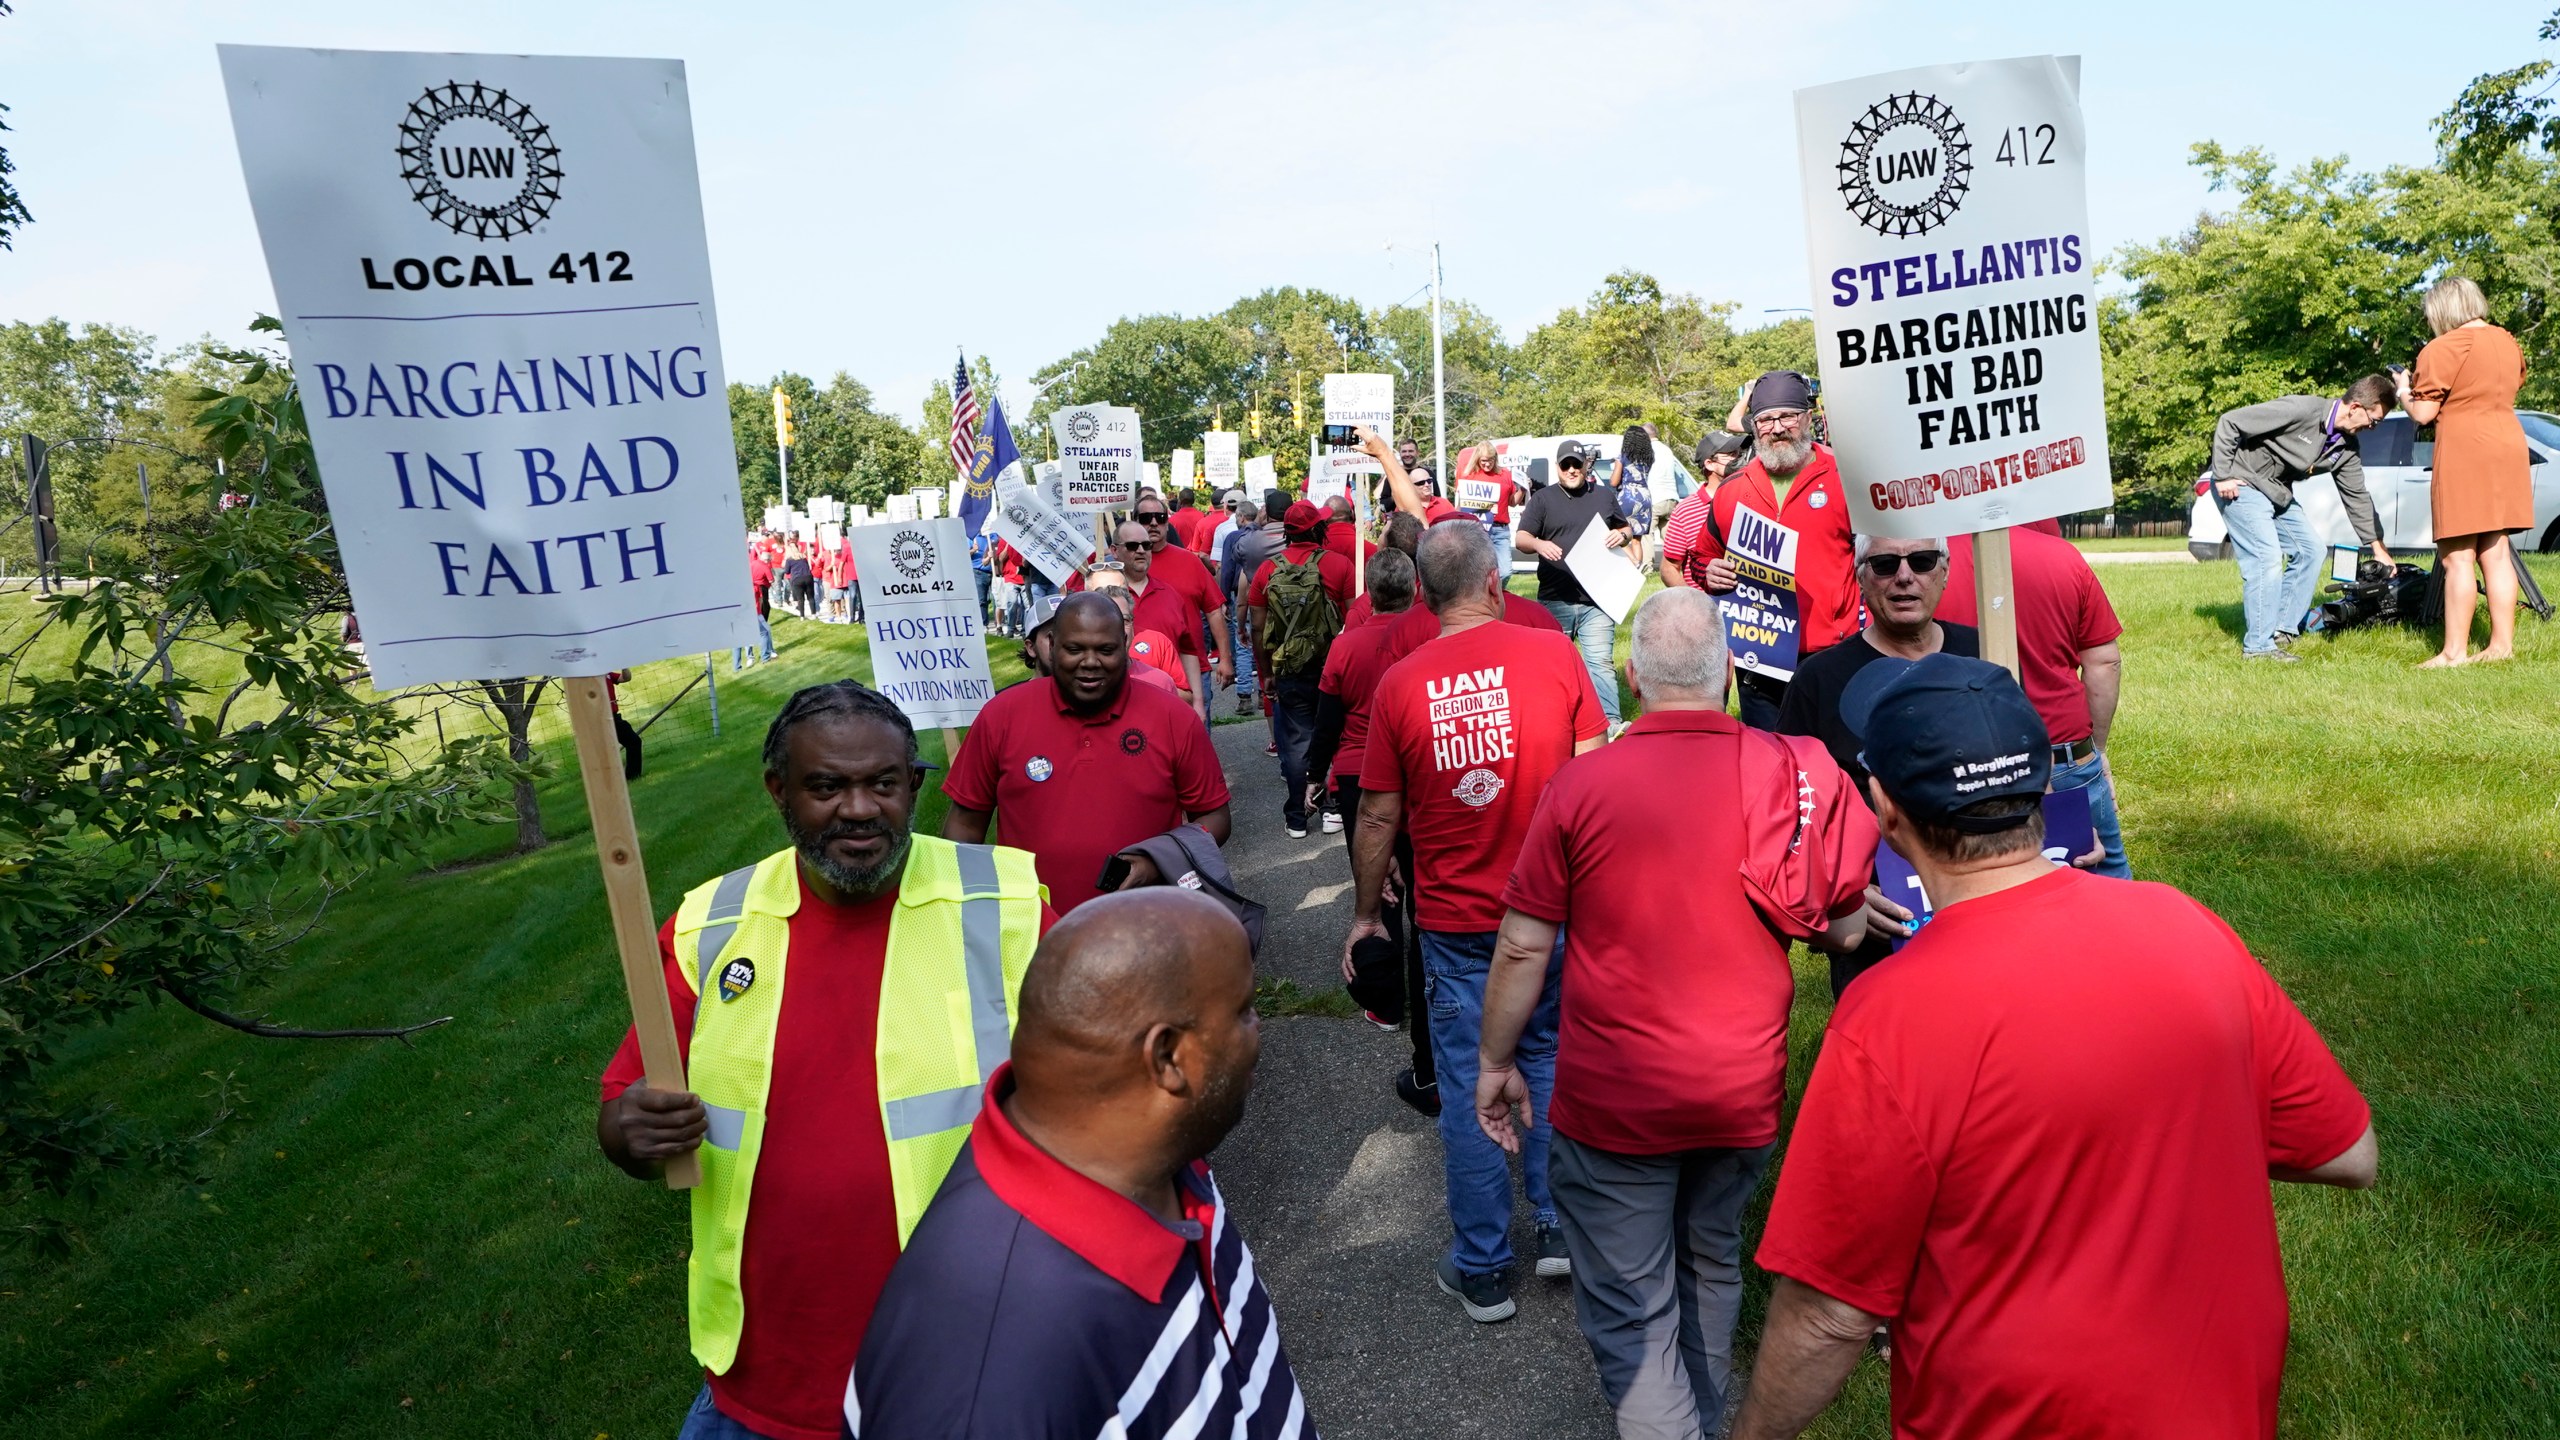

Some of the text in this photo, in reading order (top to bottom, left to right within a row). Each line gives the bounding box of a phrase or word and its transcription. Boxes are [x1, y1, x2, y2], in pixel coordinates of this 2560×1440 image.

[1995, 123, 2056, 168] 412
[440, 147, 514, 179] UAW
[1876, 147, 1937, 184] UAW
[361, 250, 633, 291] LOCAL 412
[1830, 234, 2082, 307] STELLANTIS
[1836, 293, 2087, 369] BARGAINING
[312, 346, 708, 419] BARGAINING
[1906, 347, 2044, 405] IN BAD
[1106, 422, 1127, 433] 412
[1328, 411, 1391, 421] STELLANTIS
[1918, 393, 2041, 450] FAITH
[1064, 446, 1132, 458] STELLANTIS
[386, 436, 680, 511] IN BAD
[1079, 461, 1119, 471] UNFAIR
[1082, 471, 1117, 482] LABOR
[1869, 436, 2086, 512] CORPORATE GREED
[1069, 482, 1130, 493] PRACTICES
[1070, 494, 1128, 505] CORPORATE GREED
[1466, 482, 1494, 499] UAW
[1463, 501, 1488, 509] STAND
[1017, 512, 1043, 539] LOCAL 412
[1023, 516, 1062, 558] BARGAINING
[1737, 512, 1786, 564] UAW
[429, 521, 674, 597] FAITH
[901, 549, 921, 561] UAW
[1037, 530, 1068, 563] IN BAD
[1050, 541, 1078, 570] FAITH
[1726, 555, 1791, 588] STAND UP
[882, 580, 954, 596] LOCAL 412
[1735, 583, 1783, 609] COLA
[1718, 600, 1797, 634] FAIR PAY
[1751, 602, 1765, 610] AND
[875, 615, 975, 642] HOSTILE
[1731, 621, 1779, 647] NOW
[896, 647, 970, 671] WORK
[882, 679, 990, 704] ENVIRONMENT
[1426, 666, 1505, 700] UAW
[1433, 692, 1505, 719] REGION 2B
[1432, 710, 1512, 738] IN THE
[1432, 726, 1515, 772] HOUSE
[1028, 757, 1048, 770] 97%
[1967, 752, 2030, 774] BorgWarner
[729, 962, 754, 981] 97%
[723, 980, 746, 994] STRIKE
